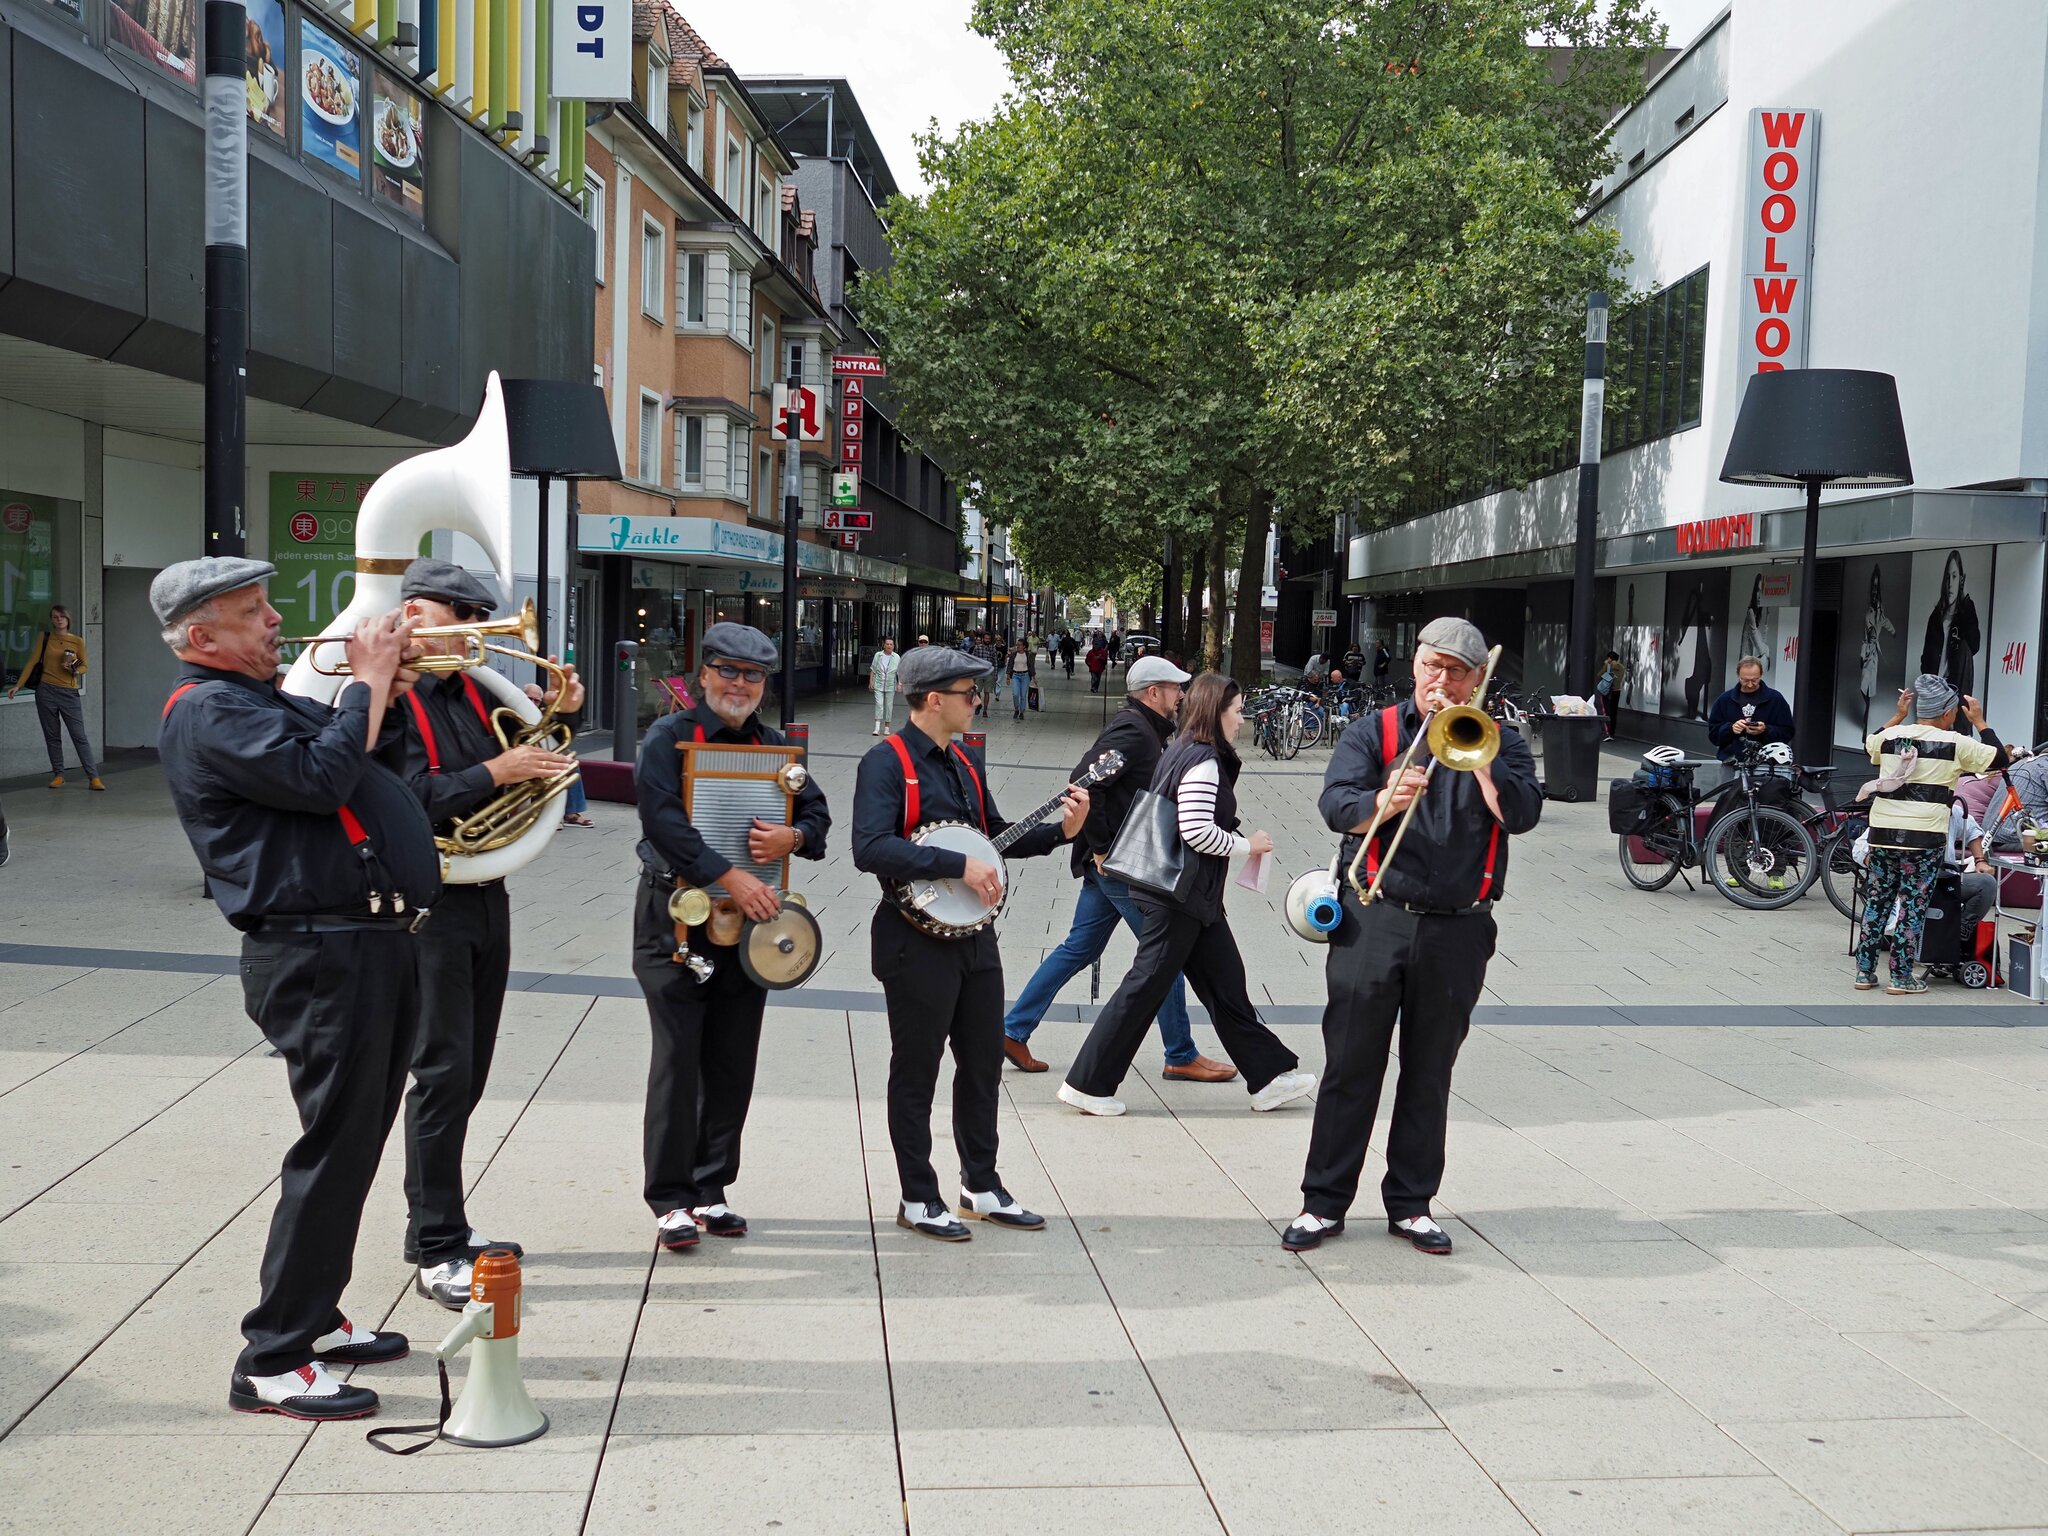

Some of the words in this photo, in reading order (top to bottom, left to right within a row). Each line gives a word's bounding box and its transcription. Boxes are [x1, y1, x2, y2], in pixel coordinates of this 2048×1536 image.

[577, 5, 604, 59] DT
[1753, 112, 1806, 374] WOOLWO
[844, 380, 860, 544] APOTHE
[609, 516, 680, 551] Jäckle
[1676, 512, 1753, 554] WOOLWORTH
[274, 551, 302, 562] jeden
[303, 552, 335, 562] ersten
[2002, 641, 2027, 677] H&M
